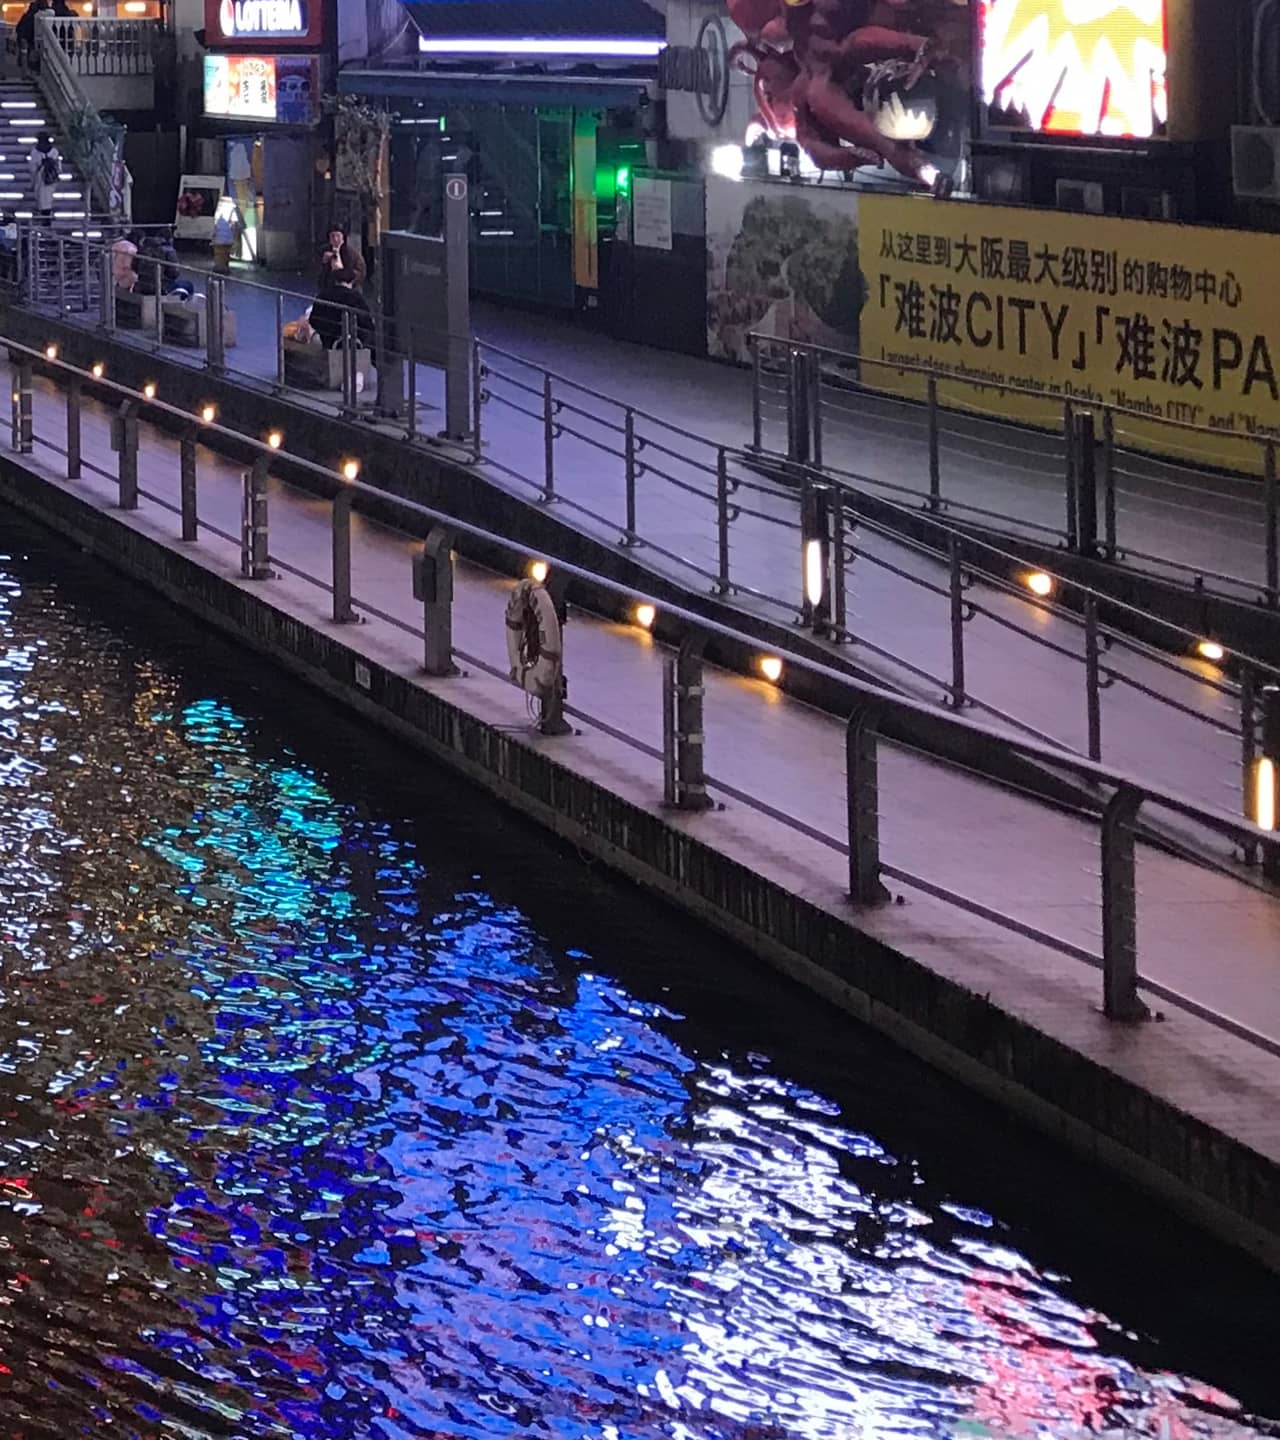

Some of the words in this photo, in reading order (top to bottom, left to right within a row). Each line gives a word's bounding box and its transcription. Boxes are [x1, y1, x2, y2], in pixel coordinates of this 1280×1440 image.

[879, 228, 1243, 309] 从这里到大阪最大级别的购物中心
